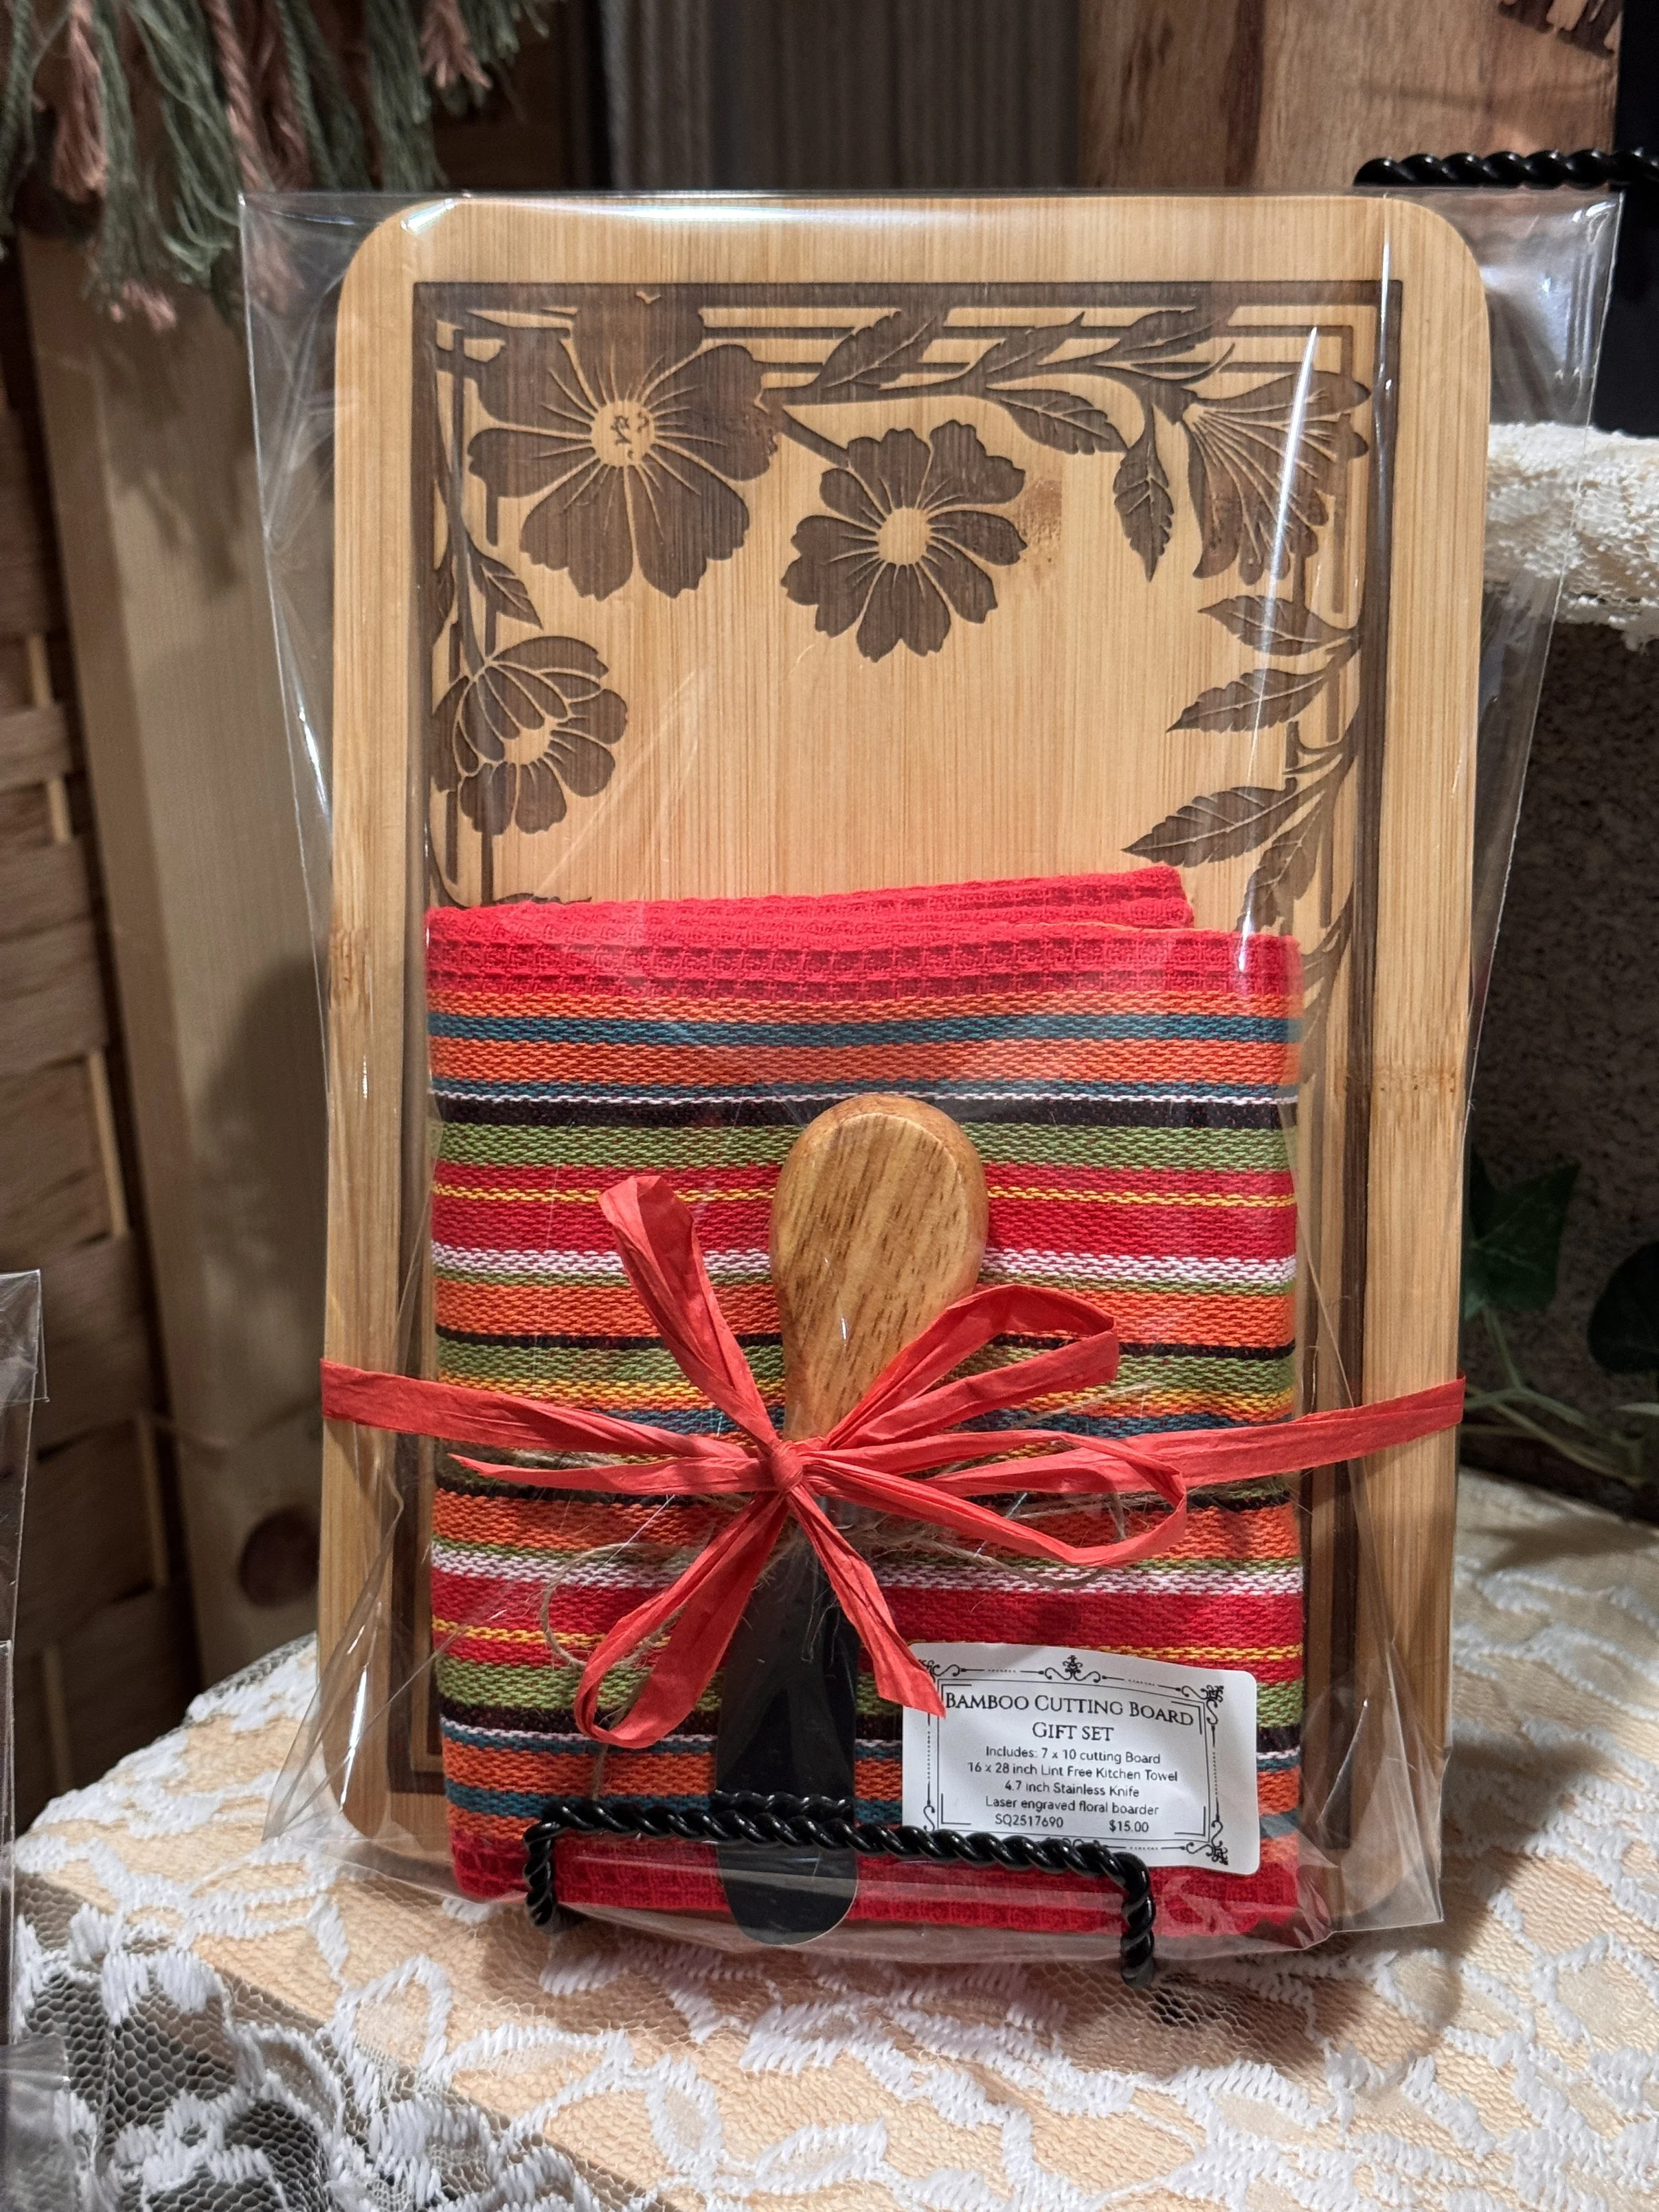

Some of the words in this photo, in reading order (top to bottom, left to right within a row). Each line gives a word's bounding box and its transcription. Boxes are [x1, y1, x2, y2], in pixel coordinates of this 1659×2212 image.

[946, 1692, 1029, 1710] BAMBOO
[1035, 1695, 1123, 1715] CUTTING
[1129, 1702, 1194, 1726] BOARD
[1033, 1722, 1077, 1739] GIFT
[1082, 1726, 1114, 1741] SET
[1041, 1747, 1048, 1759] 7
[1063, 1749, 1076, 1760] 10
[1080, 1751, 1121, 1764] cutting
[1125, 1751, 1161, 1764] Board
[968, 1762, 981, 1773] 16
[995, 1763, 1009, 1773] 28
[1013, 1763, 1037, 1775] inch
[1041, 1765, 1063, 1776] Lint
[1067, 1766, 1092, 1777] Free
[1096, 1767, 1141, 1780] Kitchen
[1145, 1769, 1178, 1781] Towel
[1005, 1780, 1021, 1791] 4.7
[1026, 1781, 1050, 1793] inch
[1053, 1783, 1106, 1796] Stainless
[1109, 1785, 1139, 1797] Knife
[985, 1795, 1017, 1808] Laser
[1021, 1800, 1076, 1812] engraved
[1079, 1801, 1108, 1812] floral
[1112, 1802, 1159, 1815] boarder
[995, 1813, 1064, 1828] SQ2517690
[1109, 1819, 1149, 1833] $15.00
